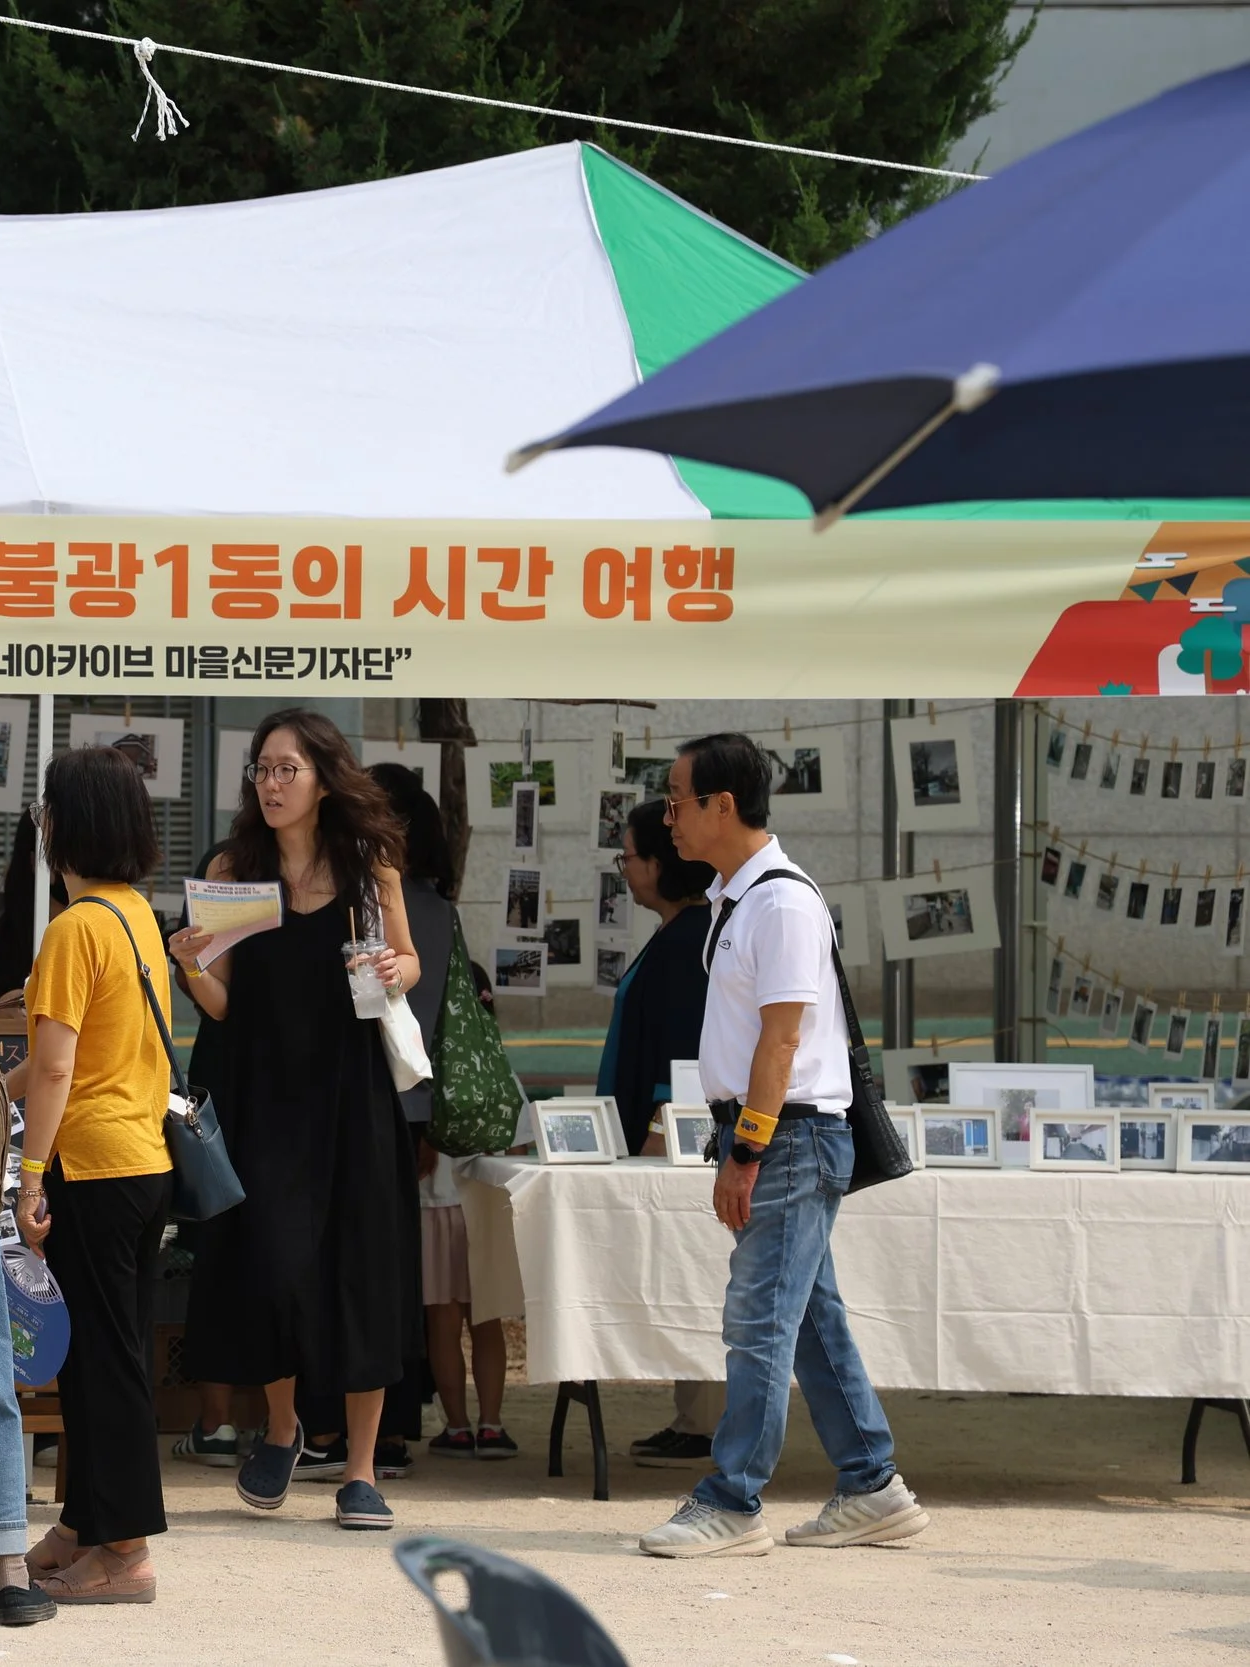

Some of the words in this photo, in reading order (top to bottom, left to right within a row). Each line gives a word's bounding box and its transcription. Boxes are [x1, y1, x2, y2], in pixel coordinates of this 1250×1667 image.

[393, 546, 553, 621] 시간
[583, 546, 735, 622] 여행
[165, 645, 412, 681] 마을신문기자단”
